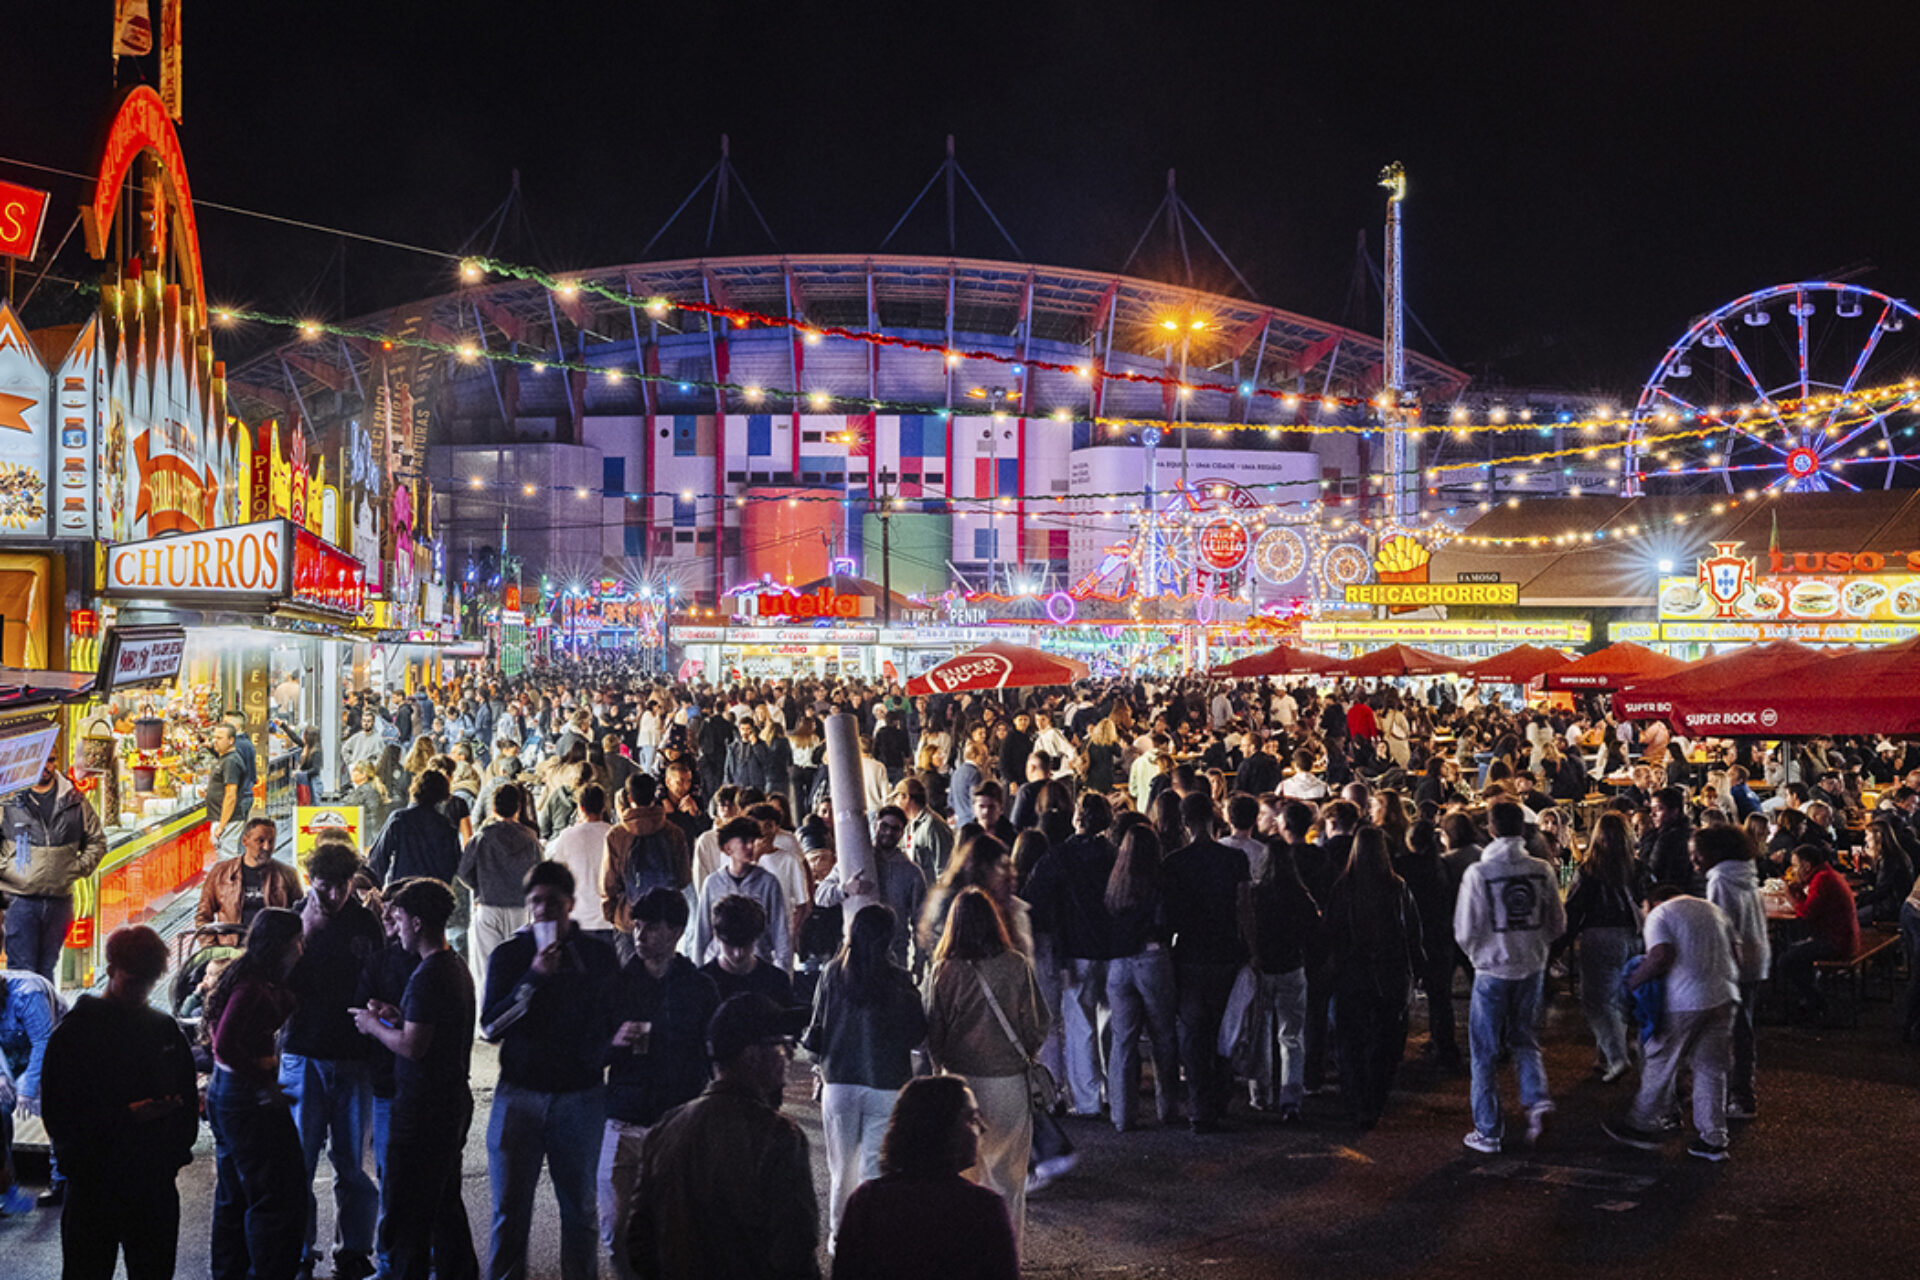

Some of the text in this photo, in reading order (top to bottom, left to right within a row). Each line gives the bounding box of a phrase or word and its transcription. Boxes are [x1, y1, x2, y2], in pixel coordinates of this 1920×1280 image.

[114, 530, 278, 589] CHURROS
[738, 587, 860, 617] nutella
[1346, 586, 1378, 603] REI
[1387, 586, 1514, 603] CACHORROS
[935, 657, 997, 680] SUPER
[944, 665, 1000, 689] BOCK
[1625, 702, 1656, 712] SUPER
[1685, 713, 1723, 727] SUPER
[1724, 711, 1757, 725] BOCK
